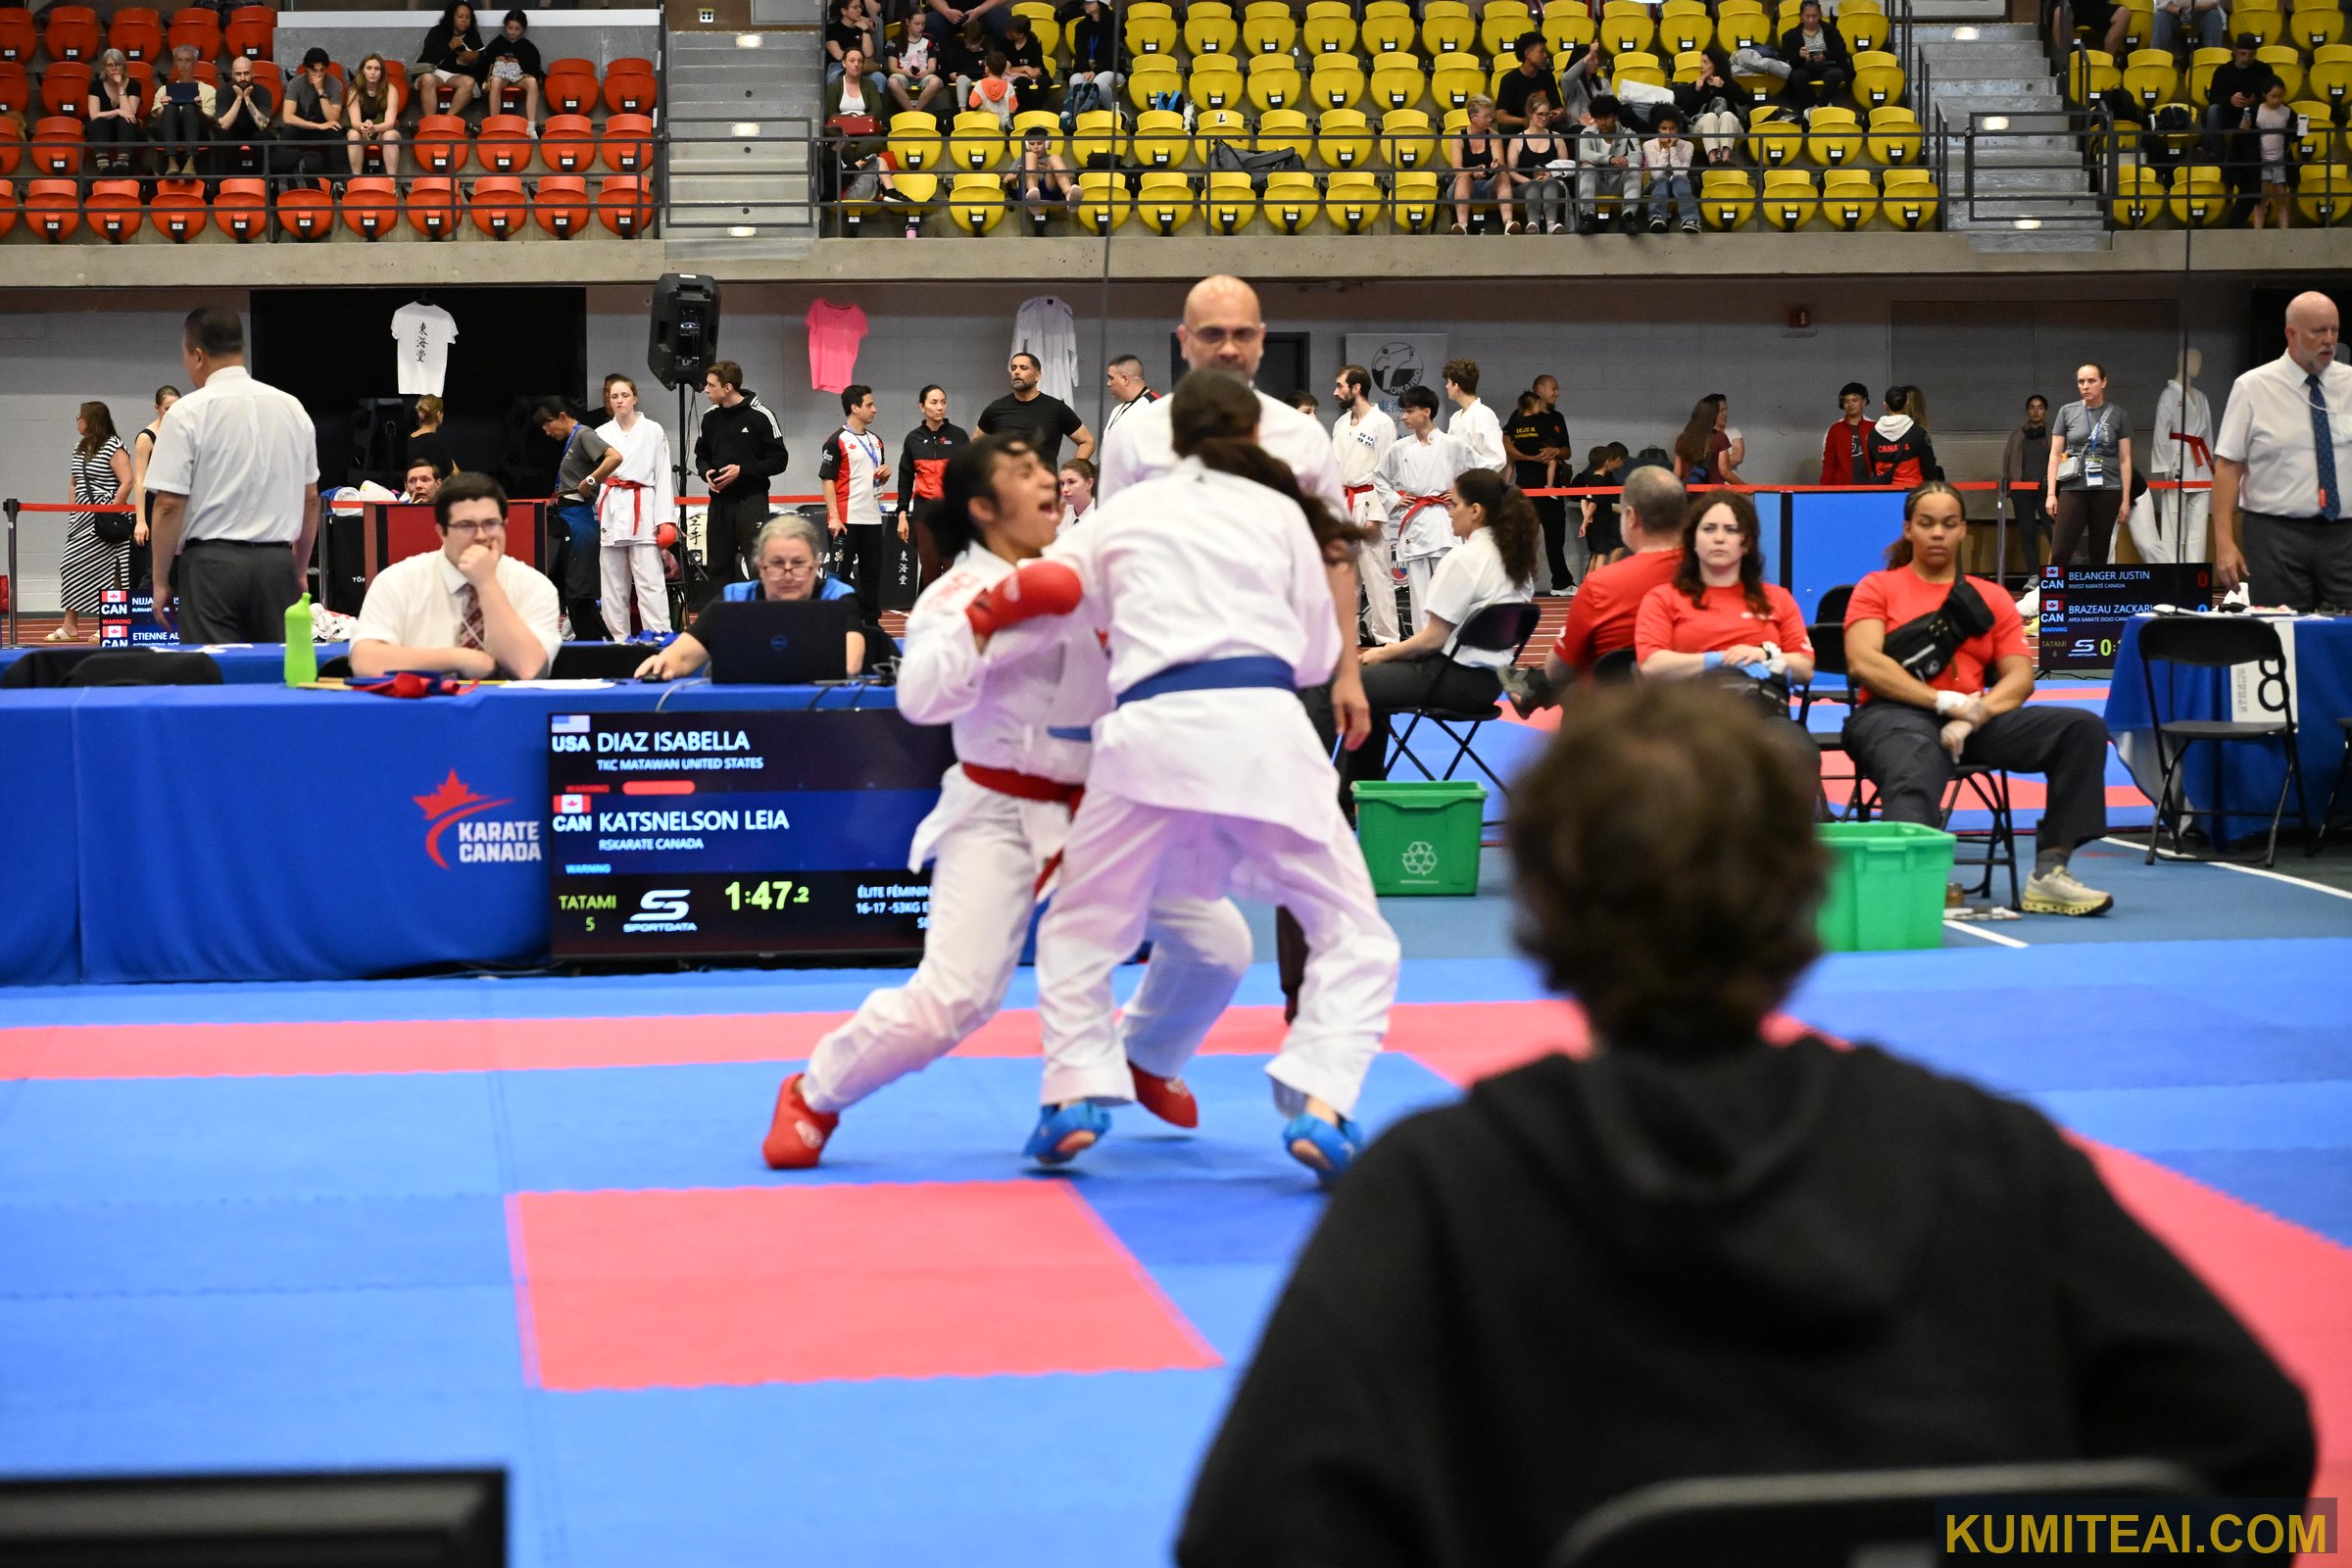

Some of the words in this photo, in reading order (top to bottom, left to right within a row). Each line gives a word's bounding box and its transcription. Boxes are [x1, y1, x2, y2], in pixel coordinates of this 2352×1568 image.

[1878, 443, 1910, 453] CANAA
[2068, 571, 2117, 581] BELANGER
[2118, 570, 2150, 580] JUSTIN
[2197, 571, 2209, 588] 0
[2040, 579, 2064, 589] CAN
[101, 604, 127, 614] CAN
[2068, 605, 2112, 614] BRAZEAU
[2040, 612, 2064, 622] CAN
[552, 736, 590, 752] USA
[597, 732, 649, 752] DIAZ
[654, 730, 750, 751] ISABELLA
[597, 760, 618, 771] TKC
[620, 759, 680, 770] MATAWAN
[681, 758, 723, 770] UNITED
[724, 757, 763, 769] STATES
[553, 815, 592, 832] CAN
[599, 810, 738, 832] KATSNELSON
[745, 809, 790, 830] LEIA
[458, 821, 540, 843] KARATE
[656, 838, 704, 850] CANADA
[459, 843, 542, 863] CANADA
[565, 863, 612, 874] WARNING
[559, 895, 616, 909] TATAMI
[856, 902, 886, 914] 16-17
[585, 917, 596, 931] 5
[622, 922, 698, 932] SPORTDATA
